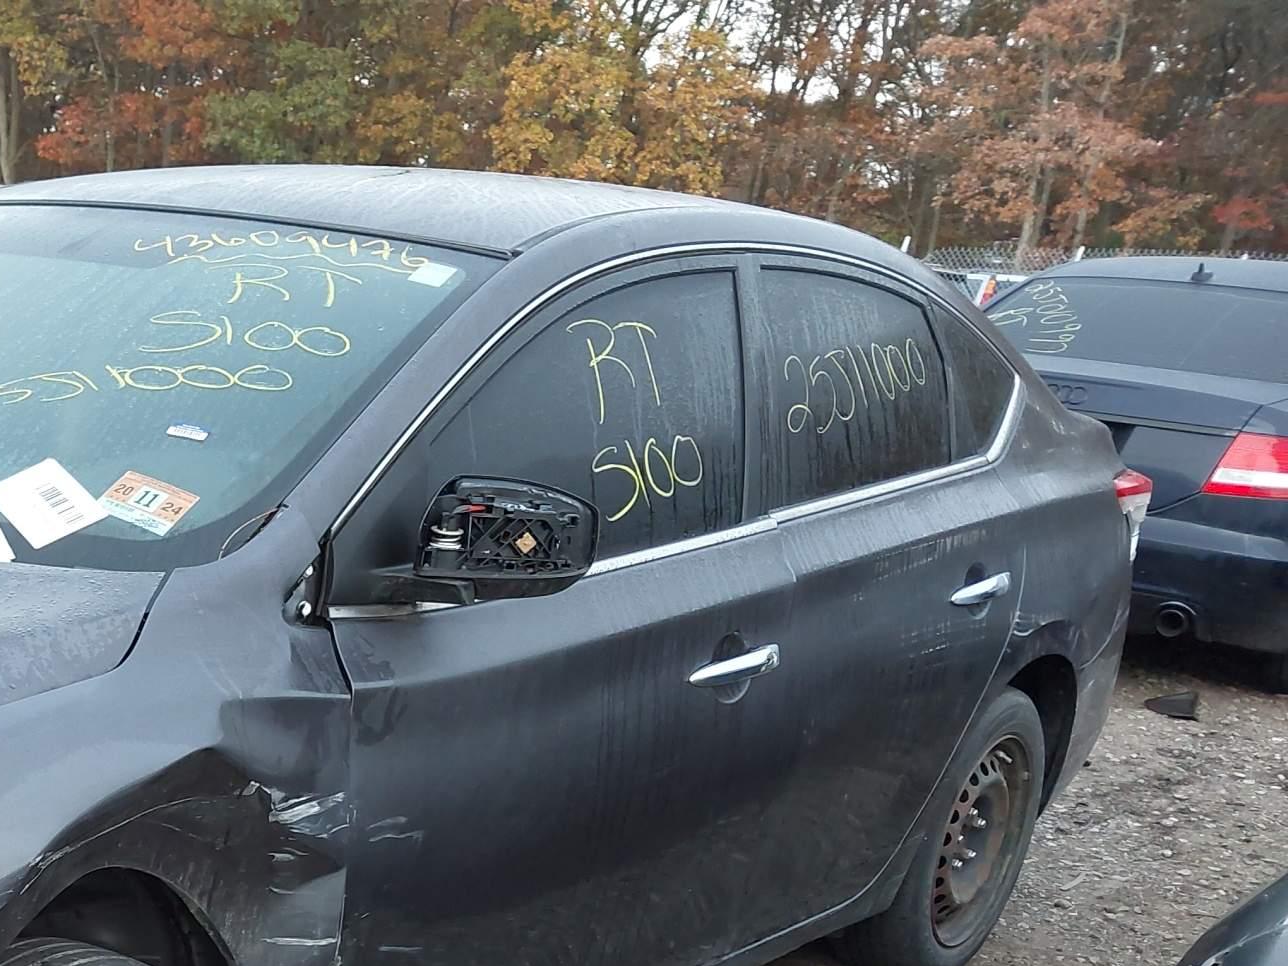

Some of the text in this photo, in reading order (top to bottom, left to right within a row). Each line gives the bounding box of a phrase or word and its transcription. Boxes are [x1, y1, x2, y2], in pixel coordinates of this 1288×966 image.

[134, 230, 430, 267] 43609476
[207, 263, 362, 308] RT
[566, 318, 661, 425] RT
[114, 483, 135, 497] 20
[133, 489, 161, 509] 11
[160, 502, 184, 516] 24
